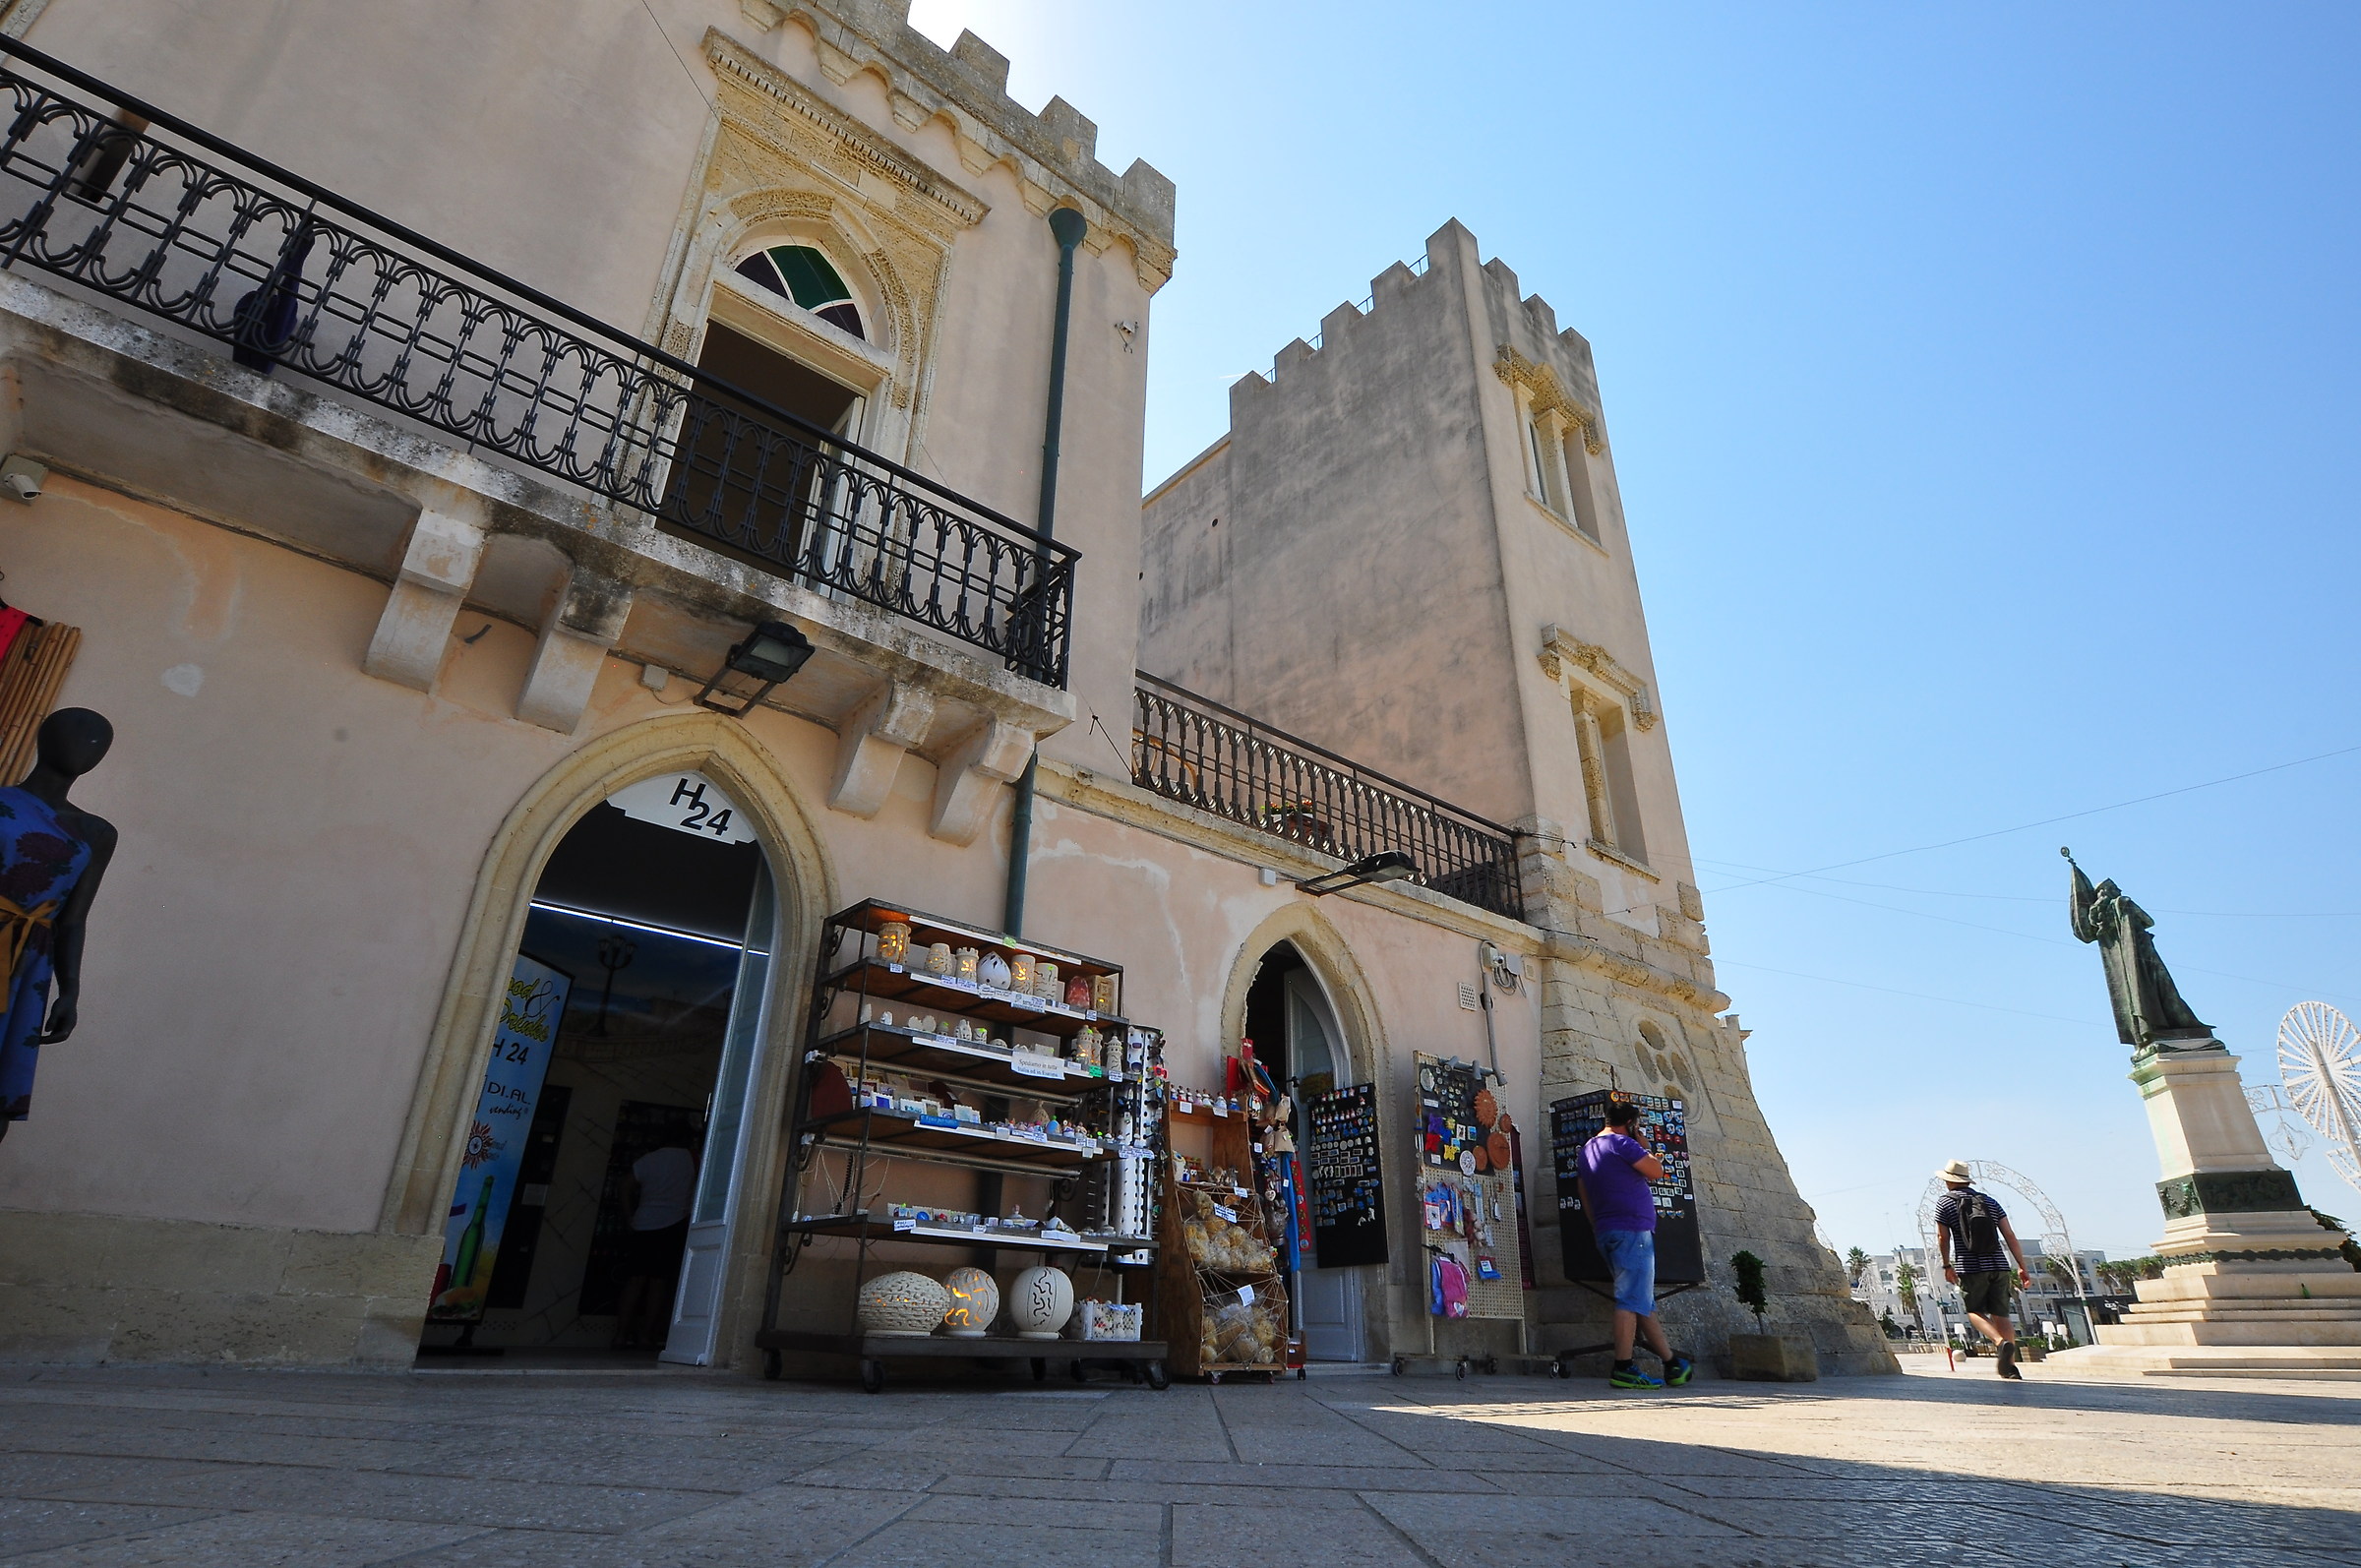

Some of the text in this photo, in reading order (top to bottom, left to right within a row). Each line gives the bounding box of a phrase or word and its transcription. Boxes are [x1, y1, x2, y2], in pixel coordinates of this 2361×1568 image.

[669, 777, 733, 836] H 24
[506, 1042, 529, 1065] 24
